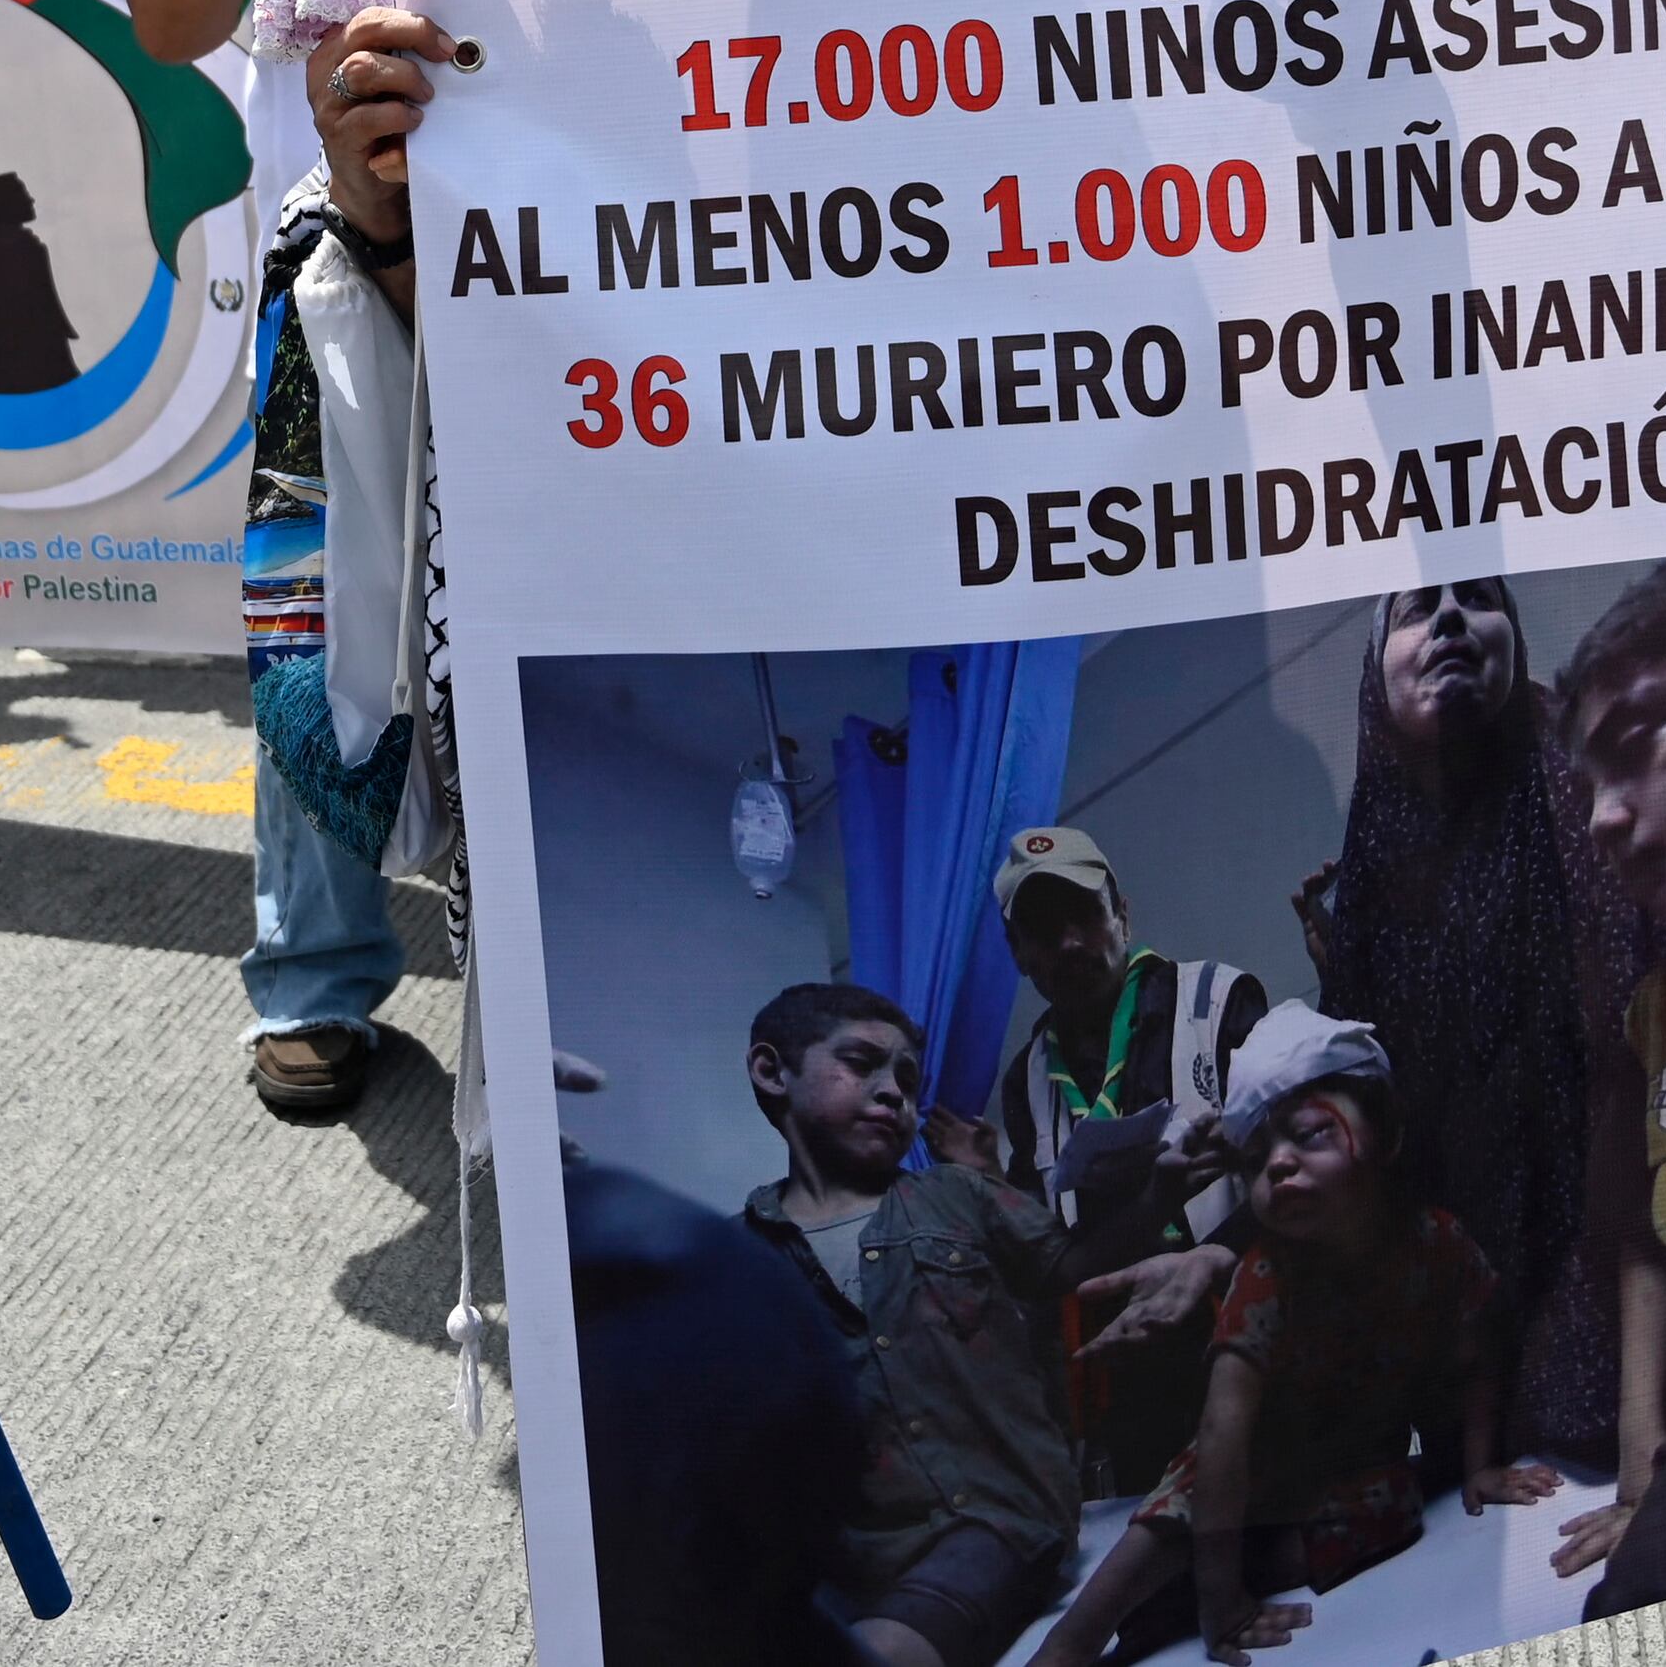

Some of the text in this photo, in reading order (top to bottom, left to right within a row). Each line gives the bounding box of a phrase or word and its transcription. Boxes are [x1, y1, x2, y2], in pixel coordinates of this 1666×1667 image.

[677, 20, 1004, 131] 17.000
[451, 207, 568, 297] AL
[596, 183, 950, 290] MENOS
[984, 160, 1266, 267] 1.000
[1297, 120, 1580, 243] NIÑOS
[565, 356, 689, 449] 36
[721, 325, 1186, 443] MURIERO
[1219, 302, 1404, 408] POR
[24, 574, 158, 603] Palestina
[46, 535, 82, 561] de
